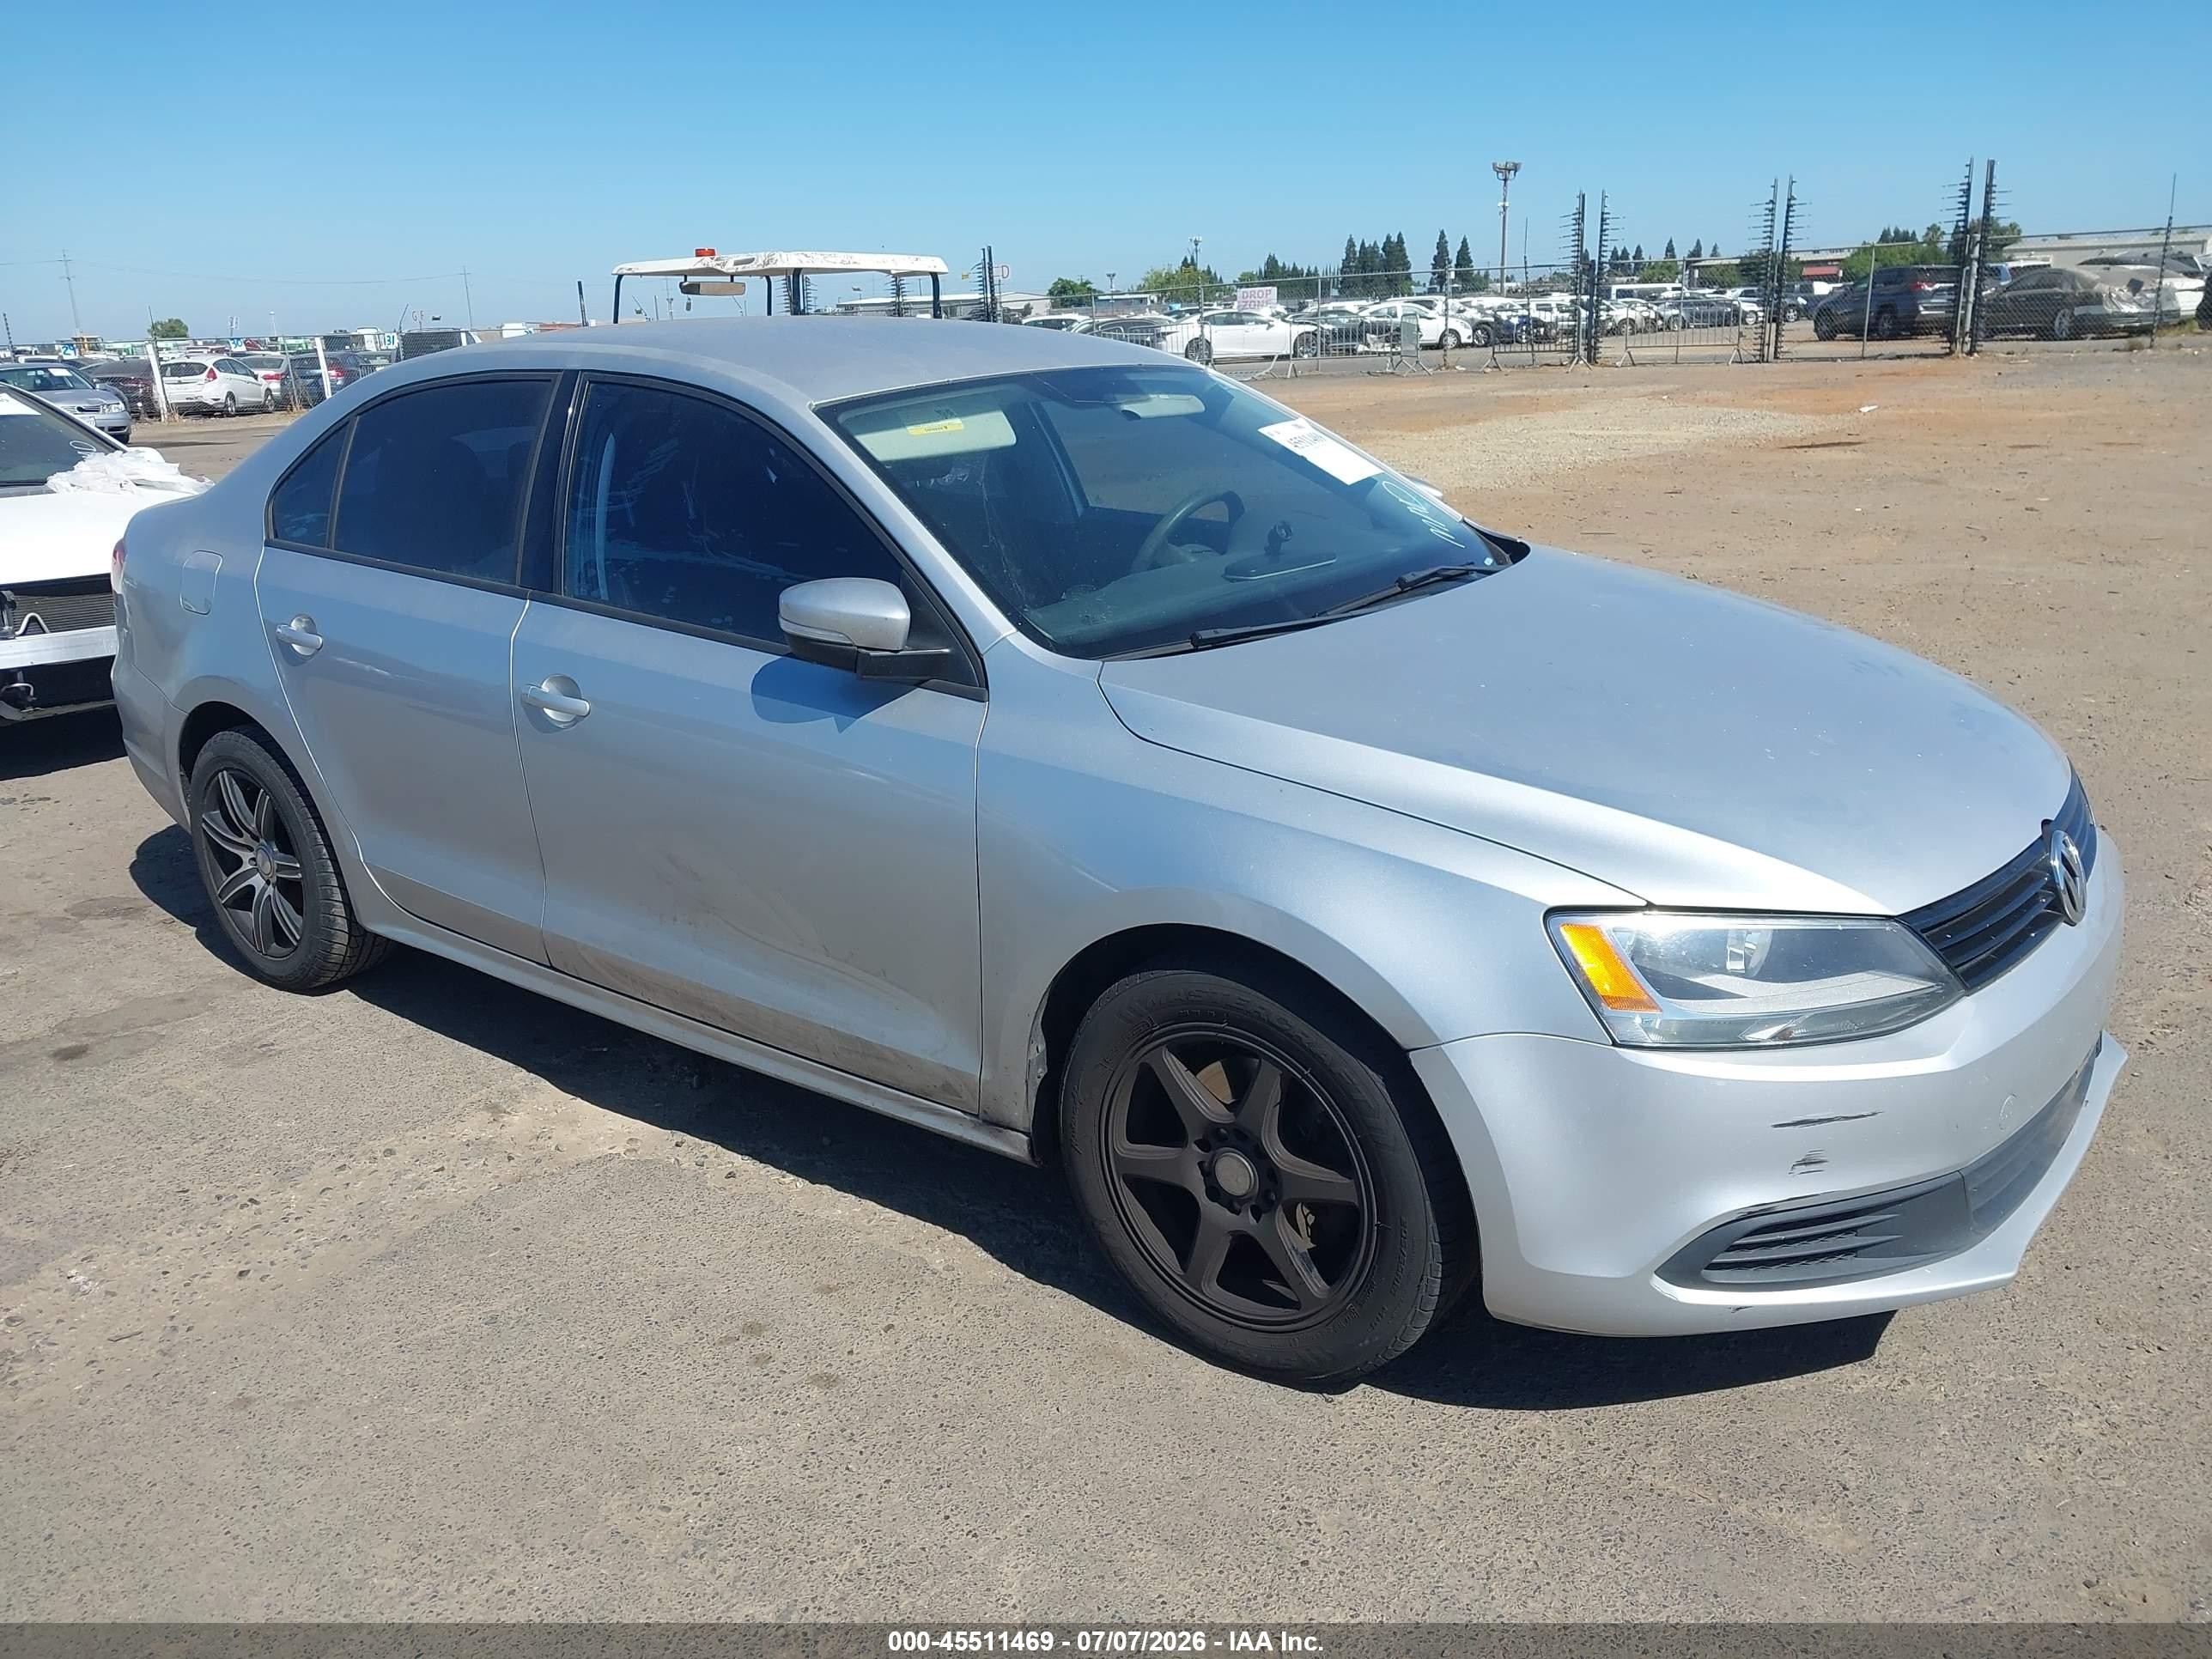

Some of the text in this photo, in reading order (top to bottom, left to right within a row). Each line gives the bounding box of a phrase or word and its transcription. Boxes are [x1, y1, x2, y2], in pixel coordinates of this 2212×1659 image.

[1242, 289, 1272, 300] DROP
[386, 335, 395, 345] 31
[62, 343, 77, 356] 29
